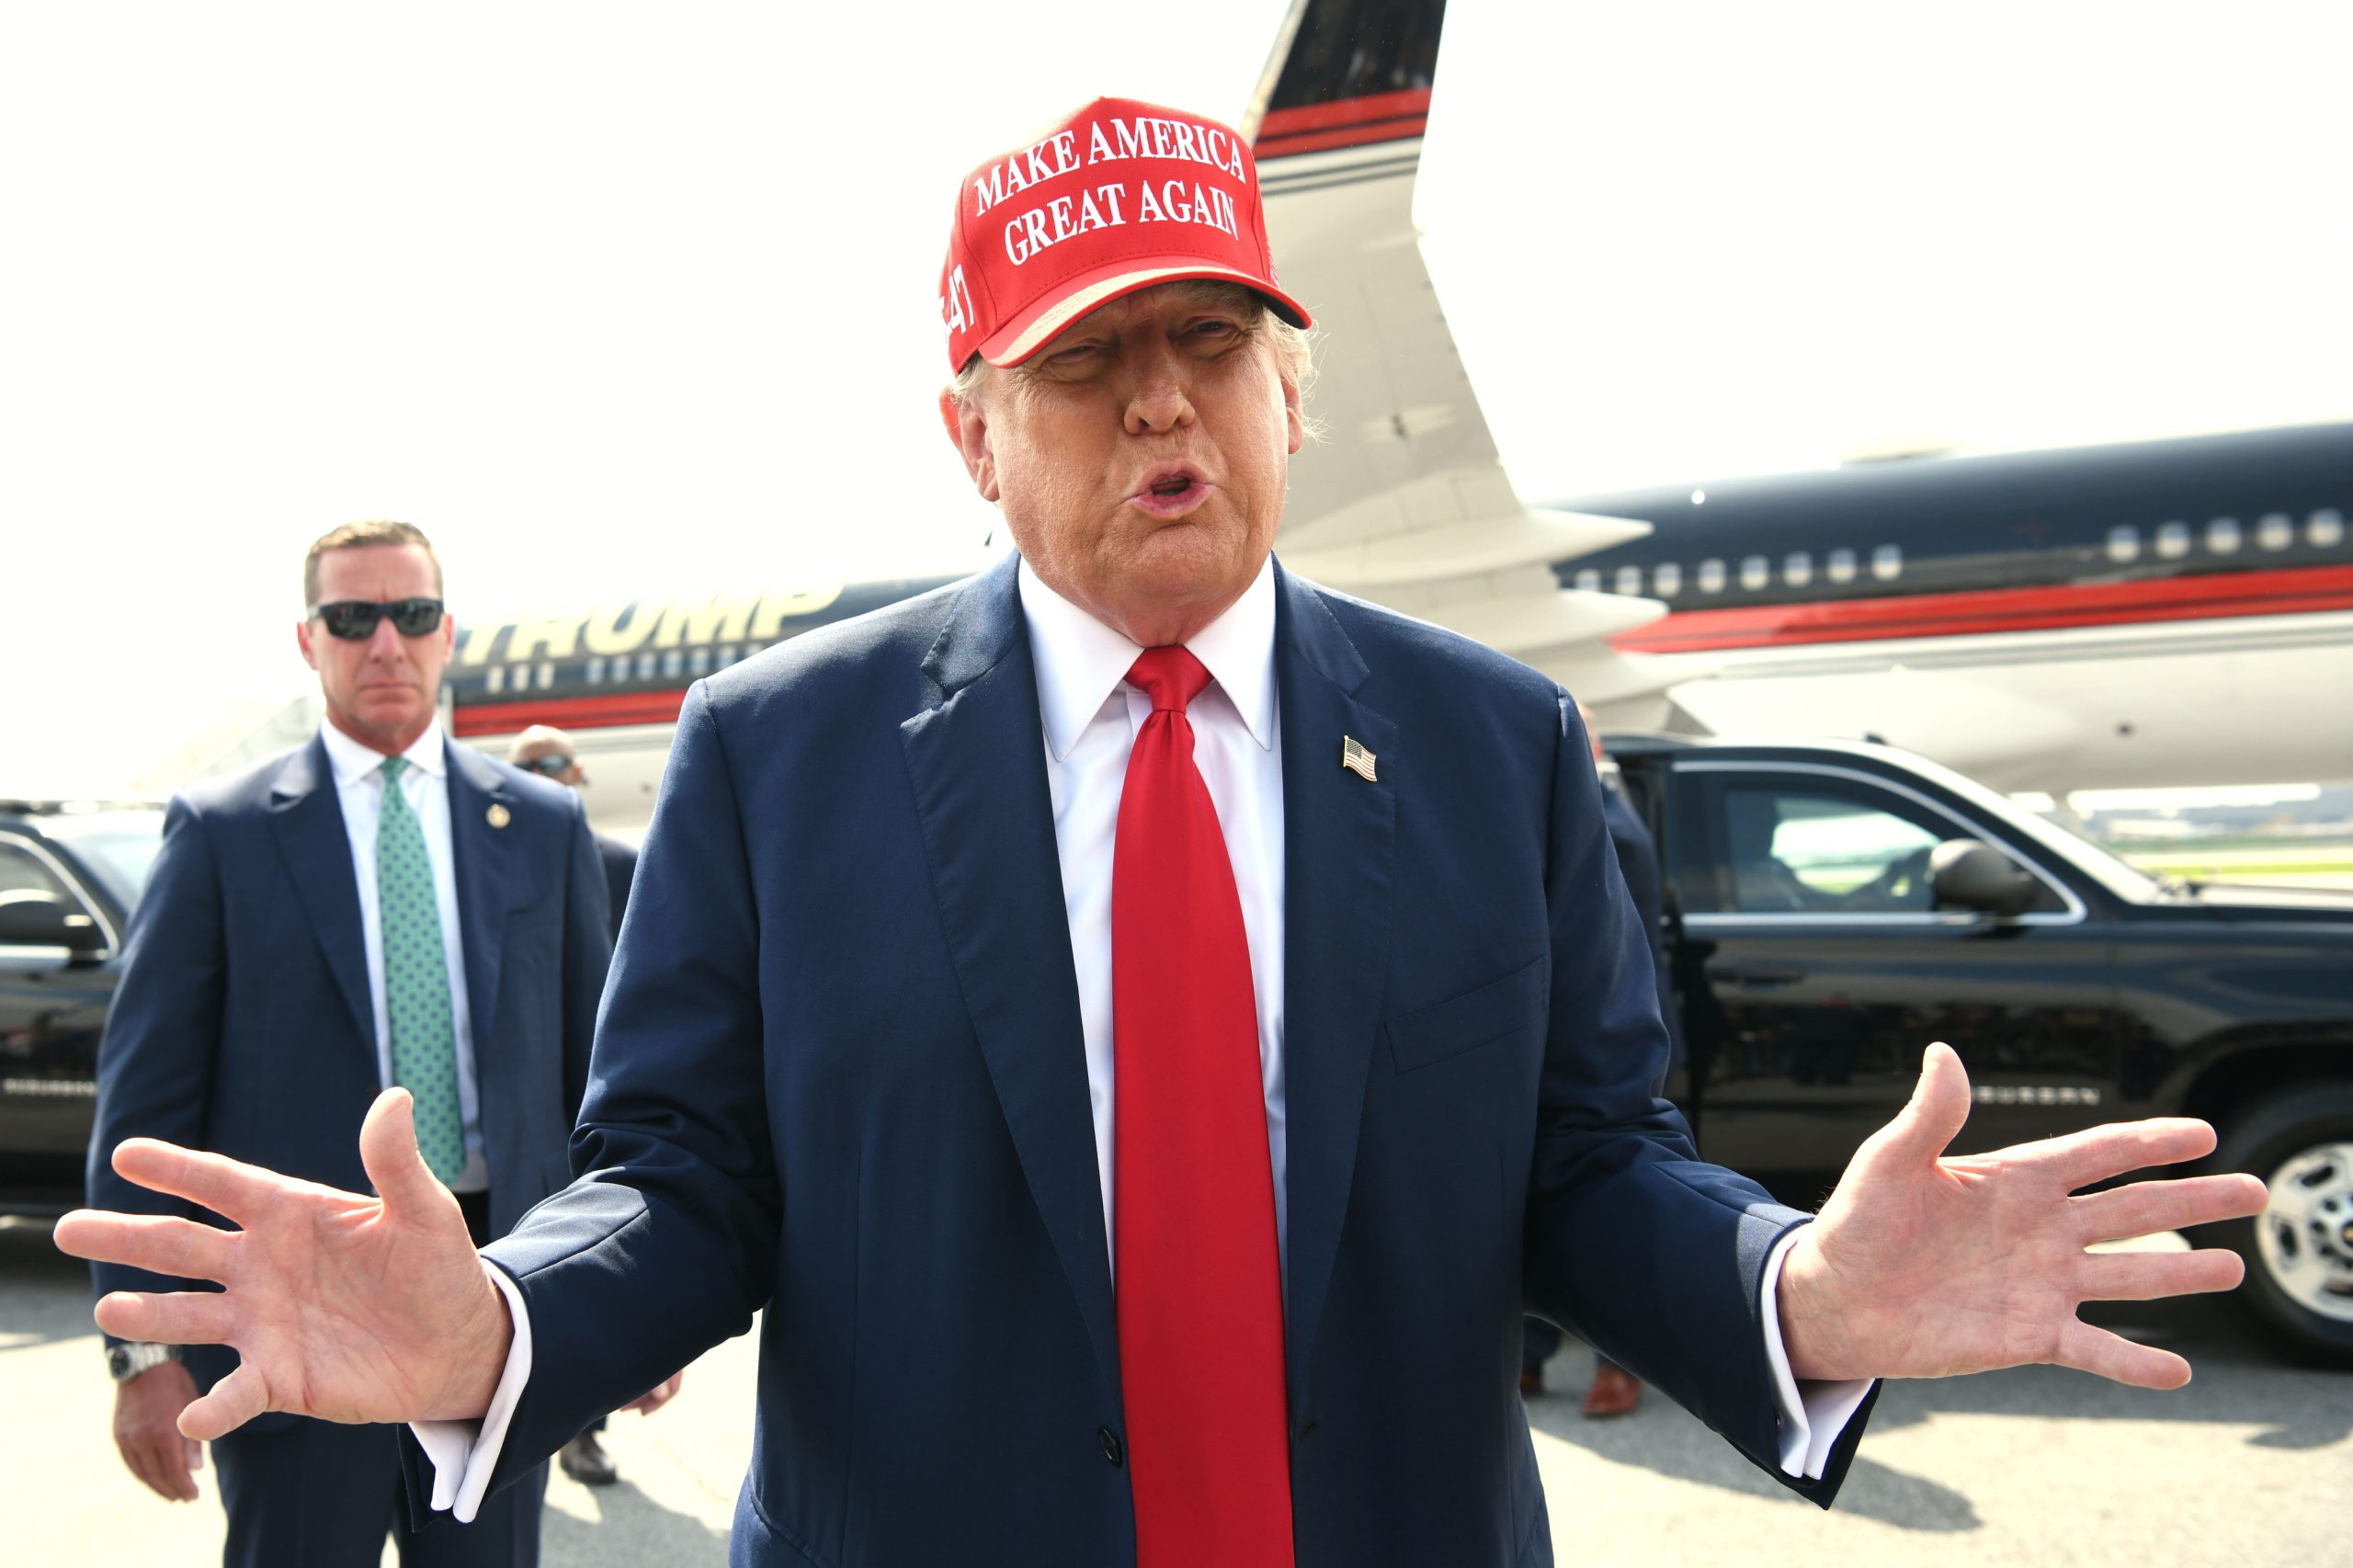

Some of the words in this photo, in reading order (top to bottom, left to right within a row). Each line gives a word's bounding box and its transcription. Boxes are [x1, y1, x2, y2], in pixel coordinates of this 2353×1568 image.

[974, 130, 1080, 217] MAKE
[1087, 117, 1246, 184] AMERICA
[1004, 183, 1126, 266] GREAT
[1140, 180, 1239, 241] AGAIN
[460, 582, 844, 665] TRUMP
